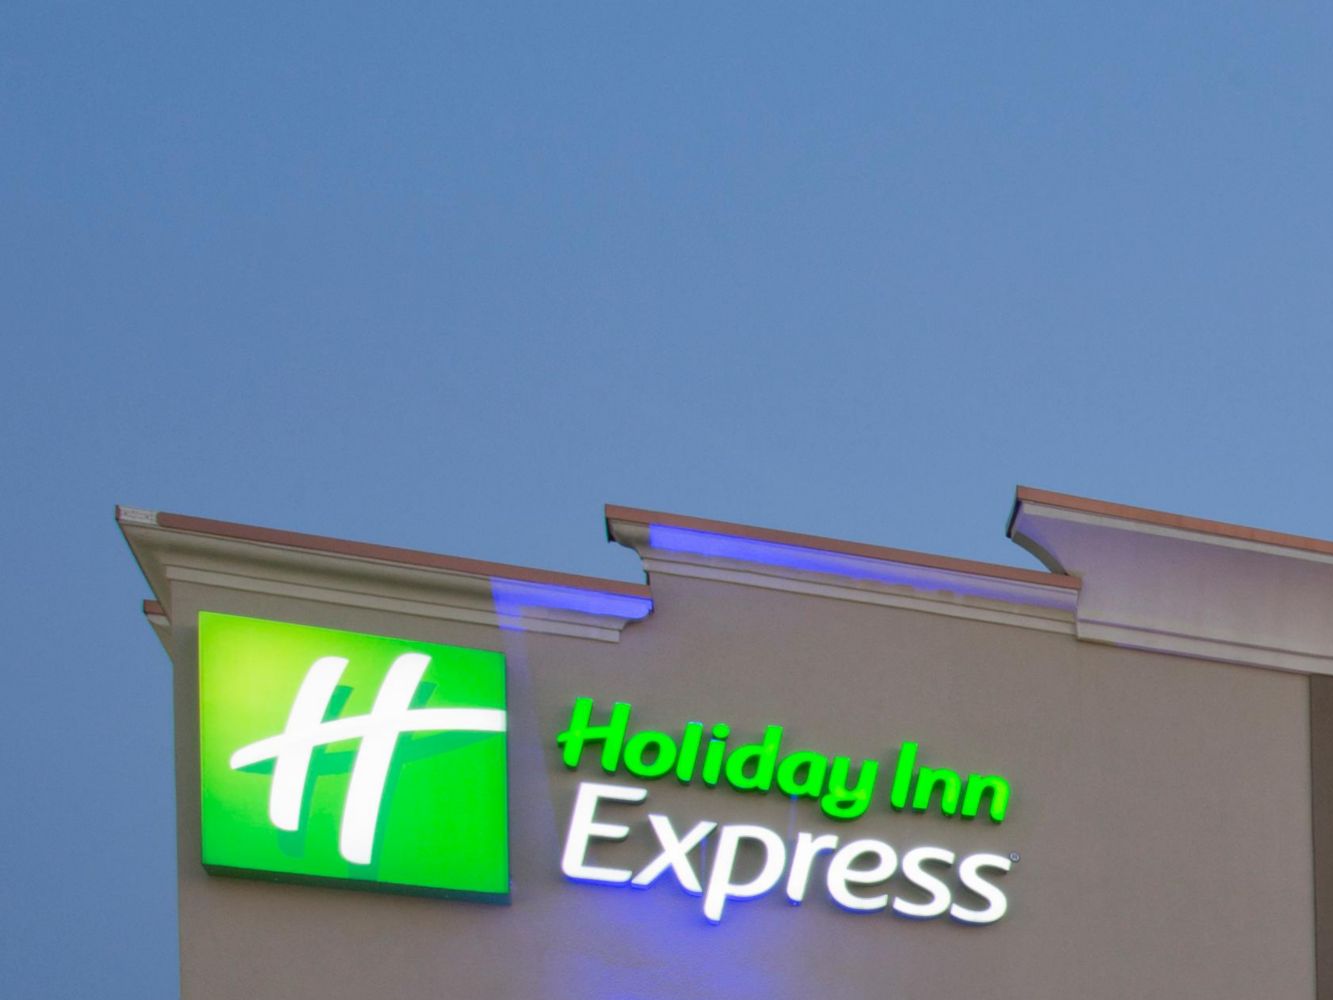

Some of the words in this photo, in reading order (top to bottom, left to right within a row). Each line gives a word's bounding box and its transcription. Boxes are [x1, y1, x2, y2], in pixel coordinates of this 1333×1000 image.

[230, 652, 507, 866] H
[557, 697, 879, 820] Holiday
[890, 742, 1012, 822] Inn
[561, 782, 1012, 925] Express
